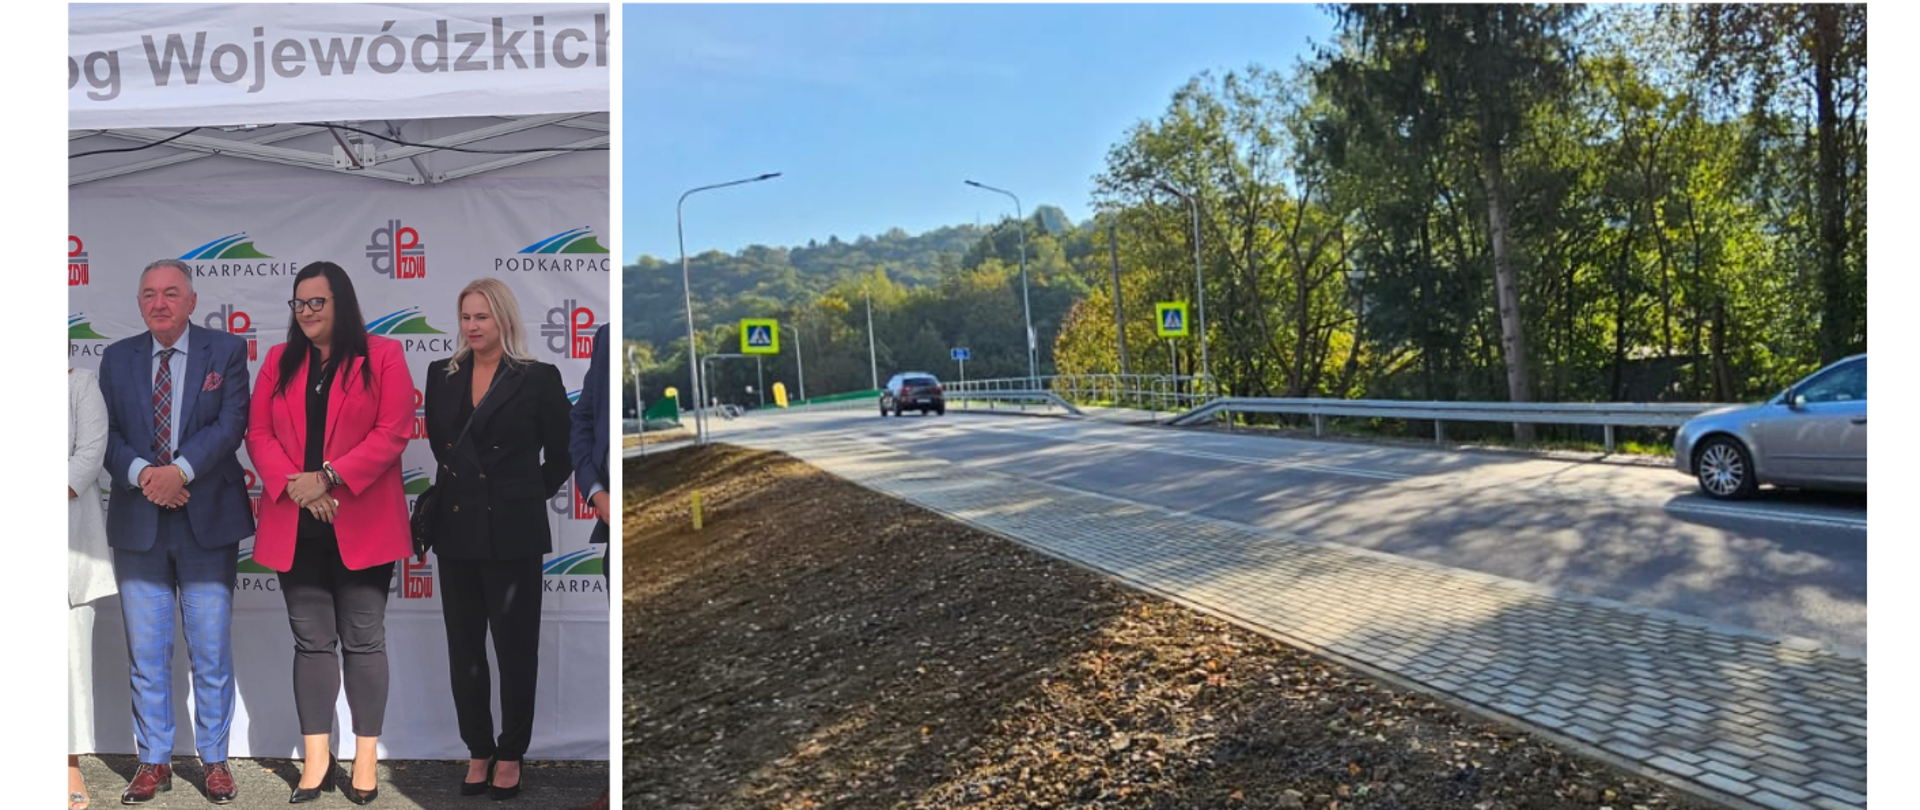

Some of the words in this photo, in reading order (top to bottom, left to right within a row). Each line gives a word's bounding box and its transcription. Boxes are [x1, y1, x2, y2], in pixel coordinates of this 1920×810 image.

[495, 258, 610, 272] PODKARPAC
[71, 344, 110, 356] PAC
[406, 339, 453, 352] PACK
[544, 580, 602, 592] KARPA
